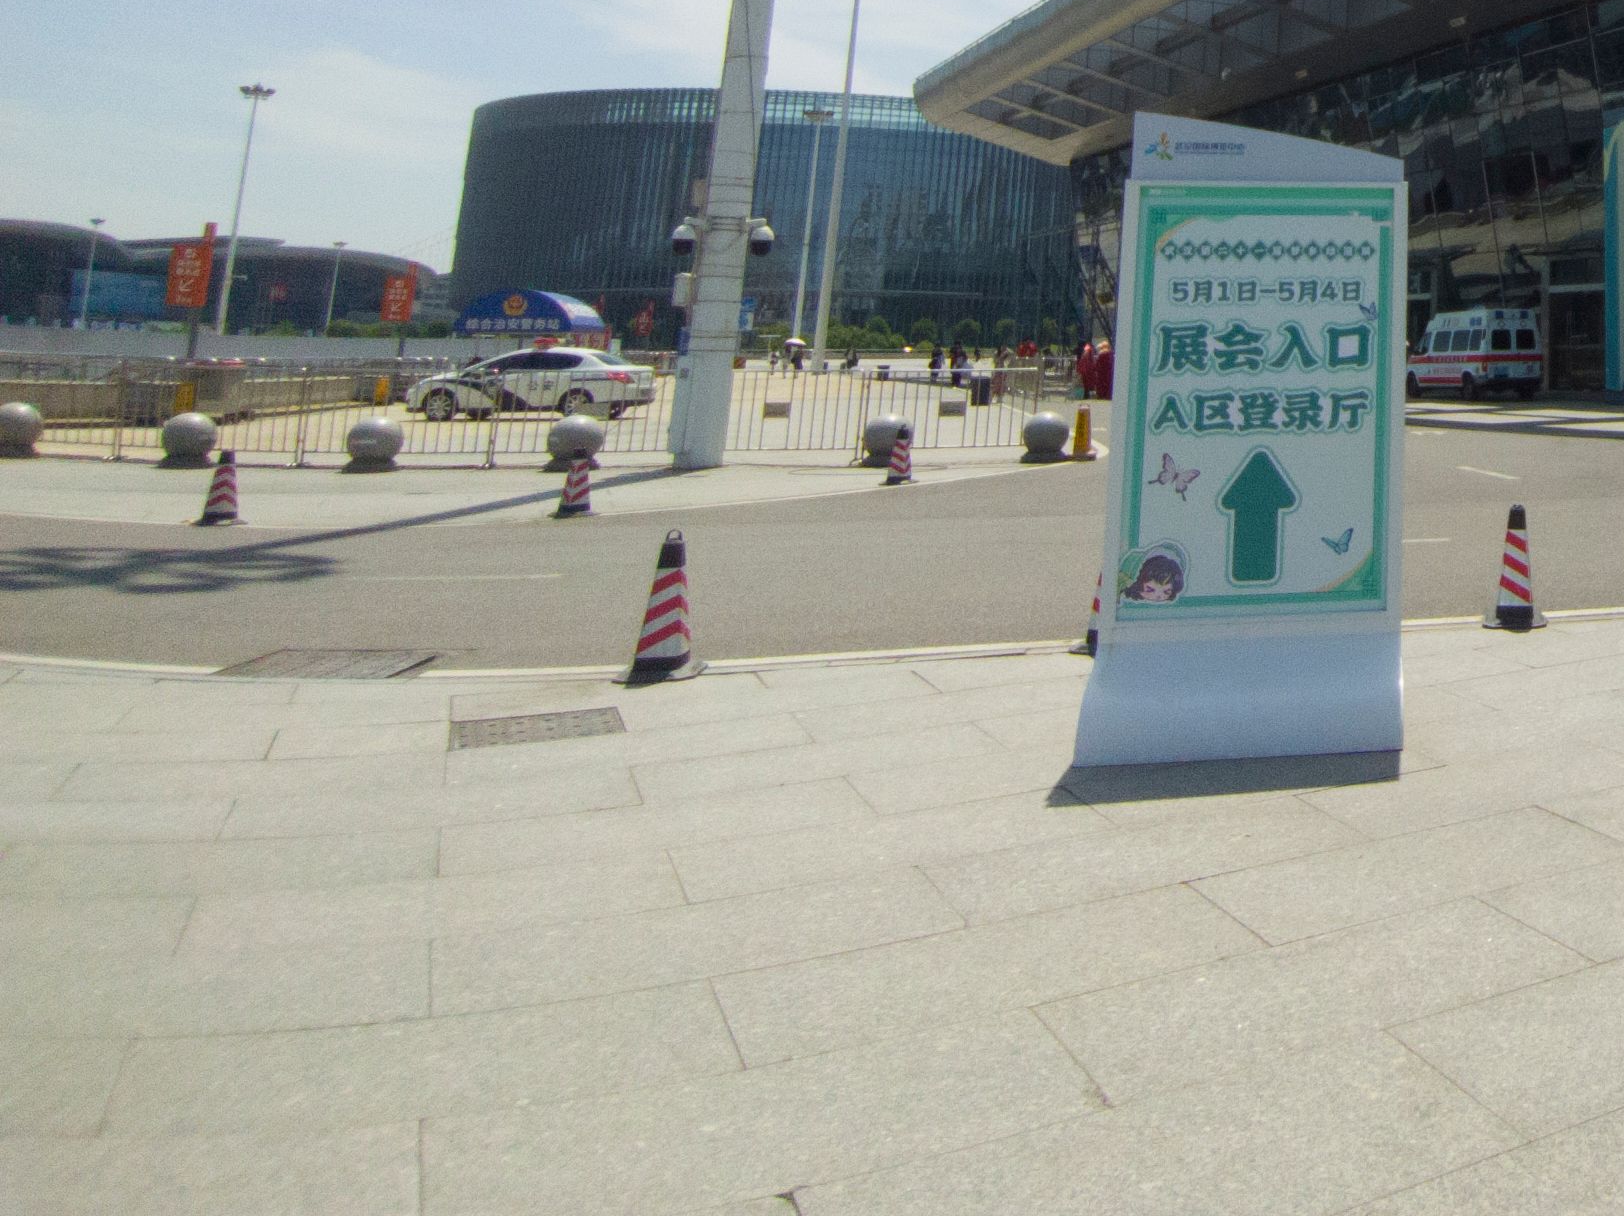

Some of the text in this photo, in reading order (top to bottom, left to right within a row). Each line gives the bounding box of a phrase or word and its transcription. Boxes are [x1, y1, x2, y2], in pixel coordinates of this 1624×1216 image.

[1172, 280, 1361, 303] 5月1日-5月4日
[1156, 323, 1372, 373] 展会入口
[1151, 391, 1370, 433] A区登录厅
